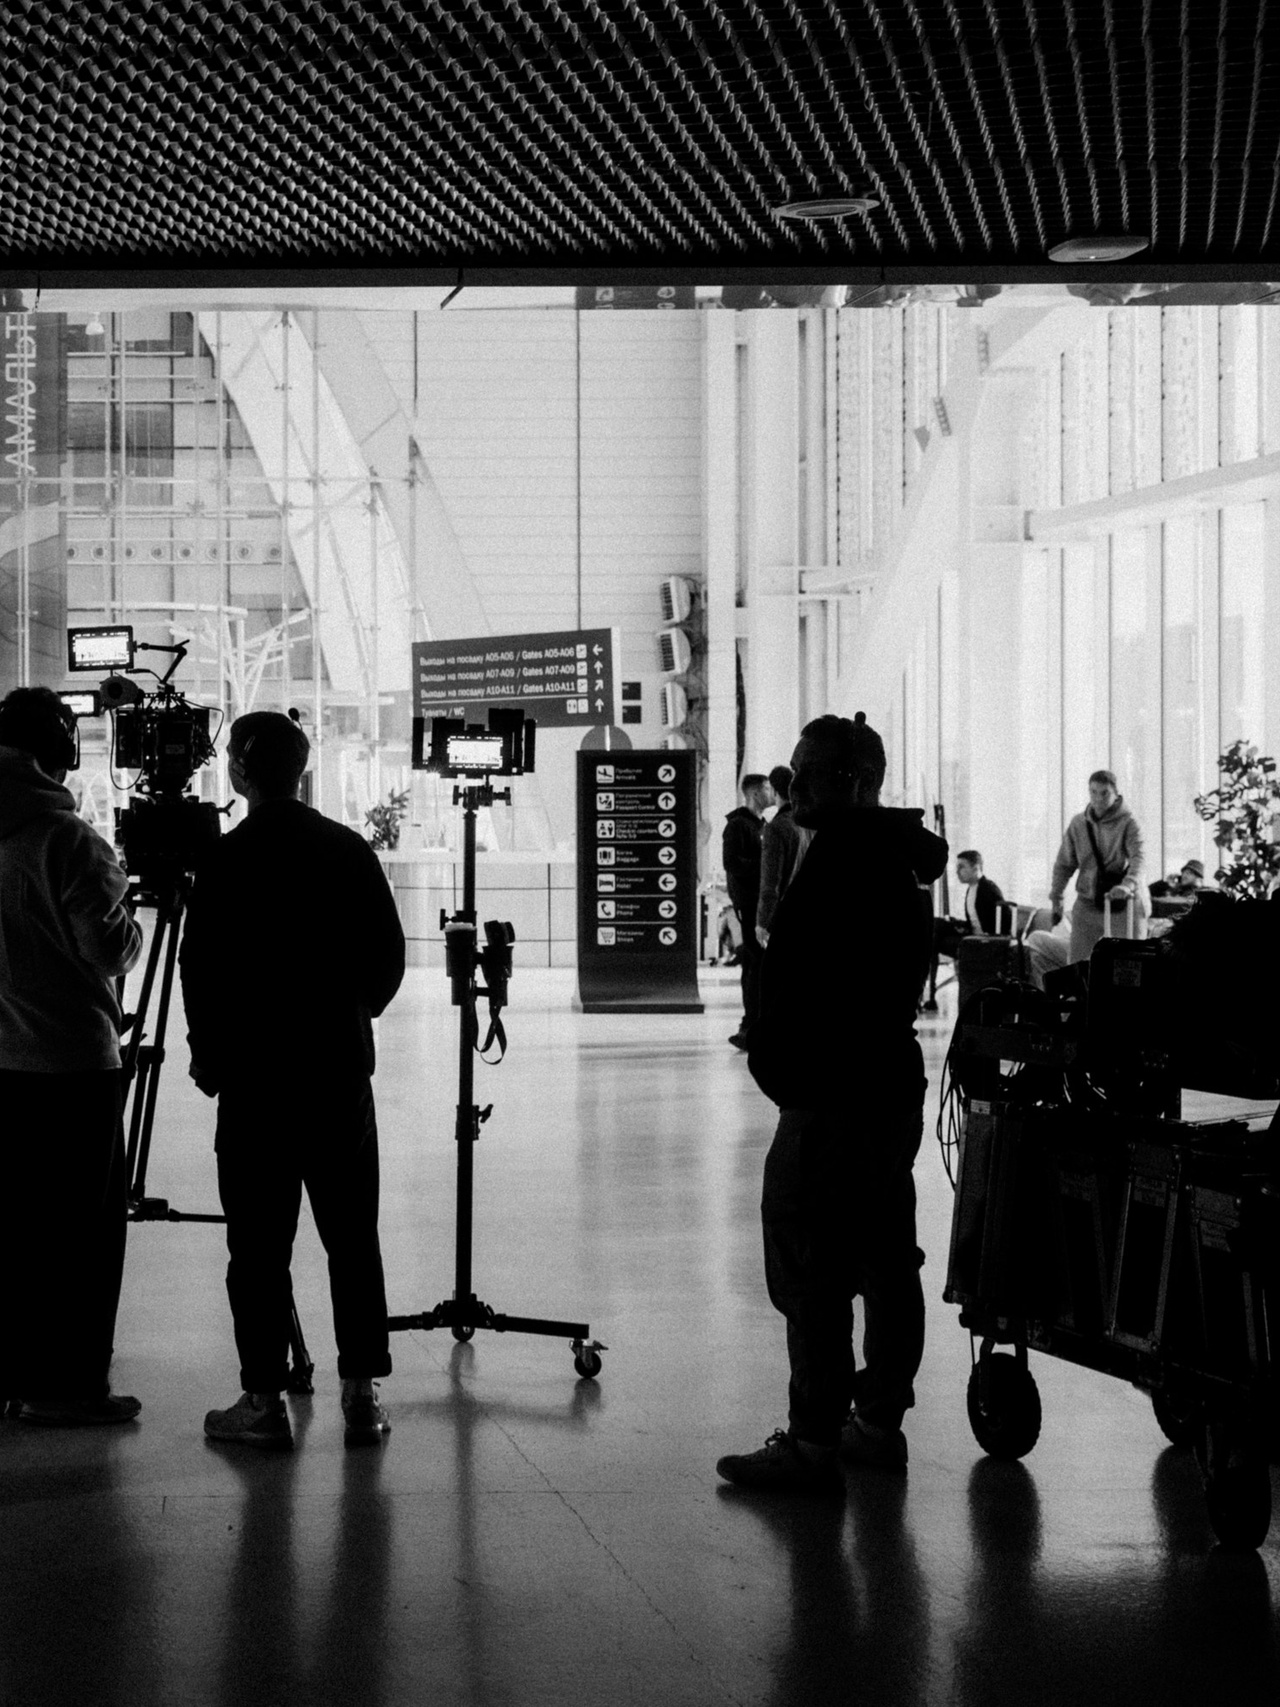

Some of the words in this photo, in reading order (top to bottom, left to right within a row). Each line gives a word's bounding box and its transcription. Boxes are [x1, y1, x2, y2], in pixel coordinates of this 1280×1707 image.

[5, 313, 36, 471] АМАЛЬТ
[521, 650, 543, 660] Gates
[522, 667, 543, 677] Gates
[523, 683, 544, 693] Gates
[454, 707, 465, 716] WC
